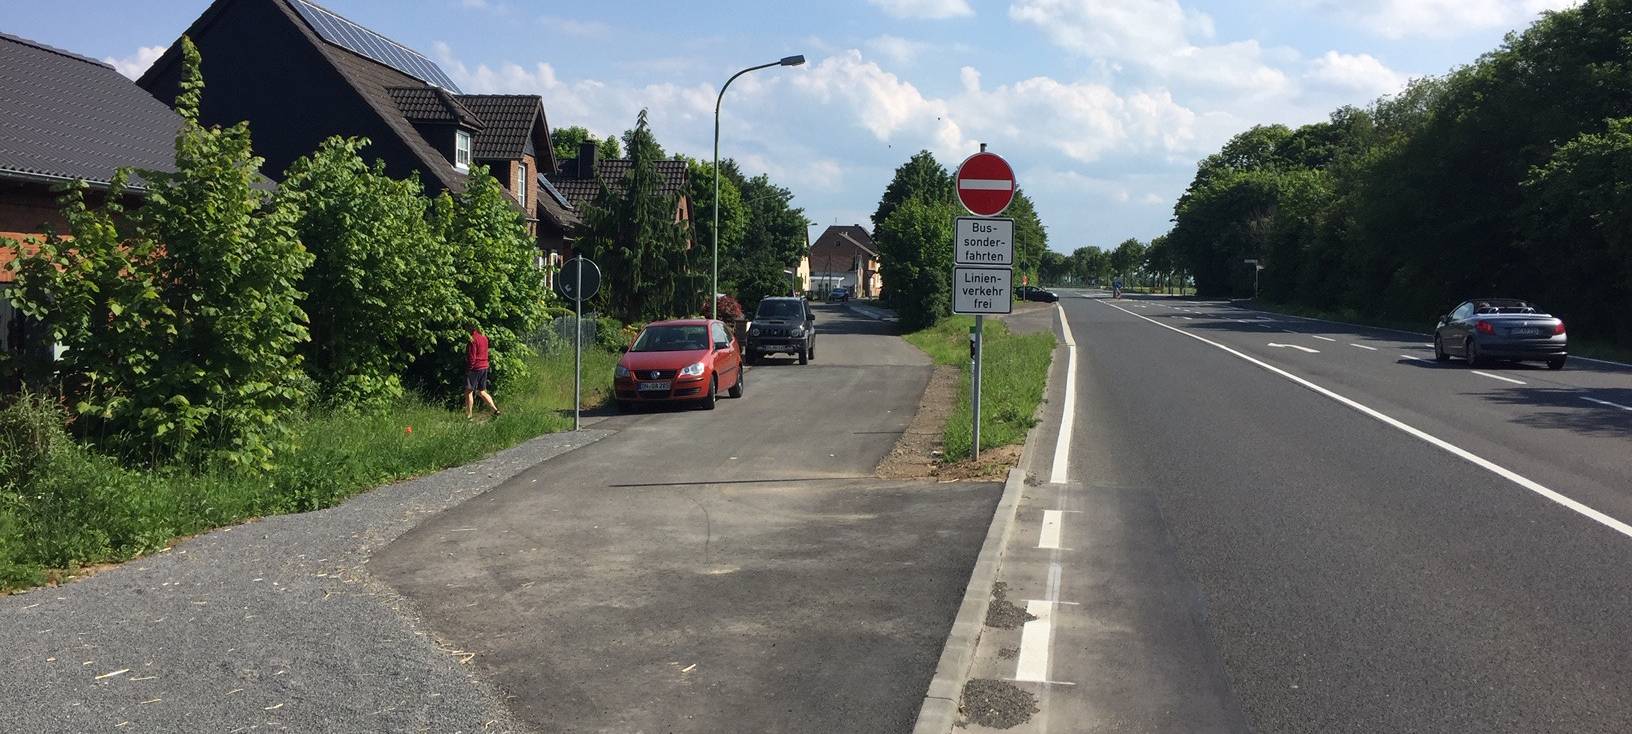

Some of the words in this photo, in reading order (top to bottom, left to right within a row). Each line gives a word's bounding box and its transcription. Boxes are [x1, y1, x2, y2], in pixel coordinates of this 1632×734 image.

[972, 222, 998, 233] Bus-
[963, 237, 1006, 247] sonder-
[965, 250, 1004, 261] fahrten
[964, 272, 1002, 283] Linien-
[962, 286, 1004, 296] verkehr
[974, 298, 992, 308] frei
